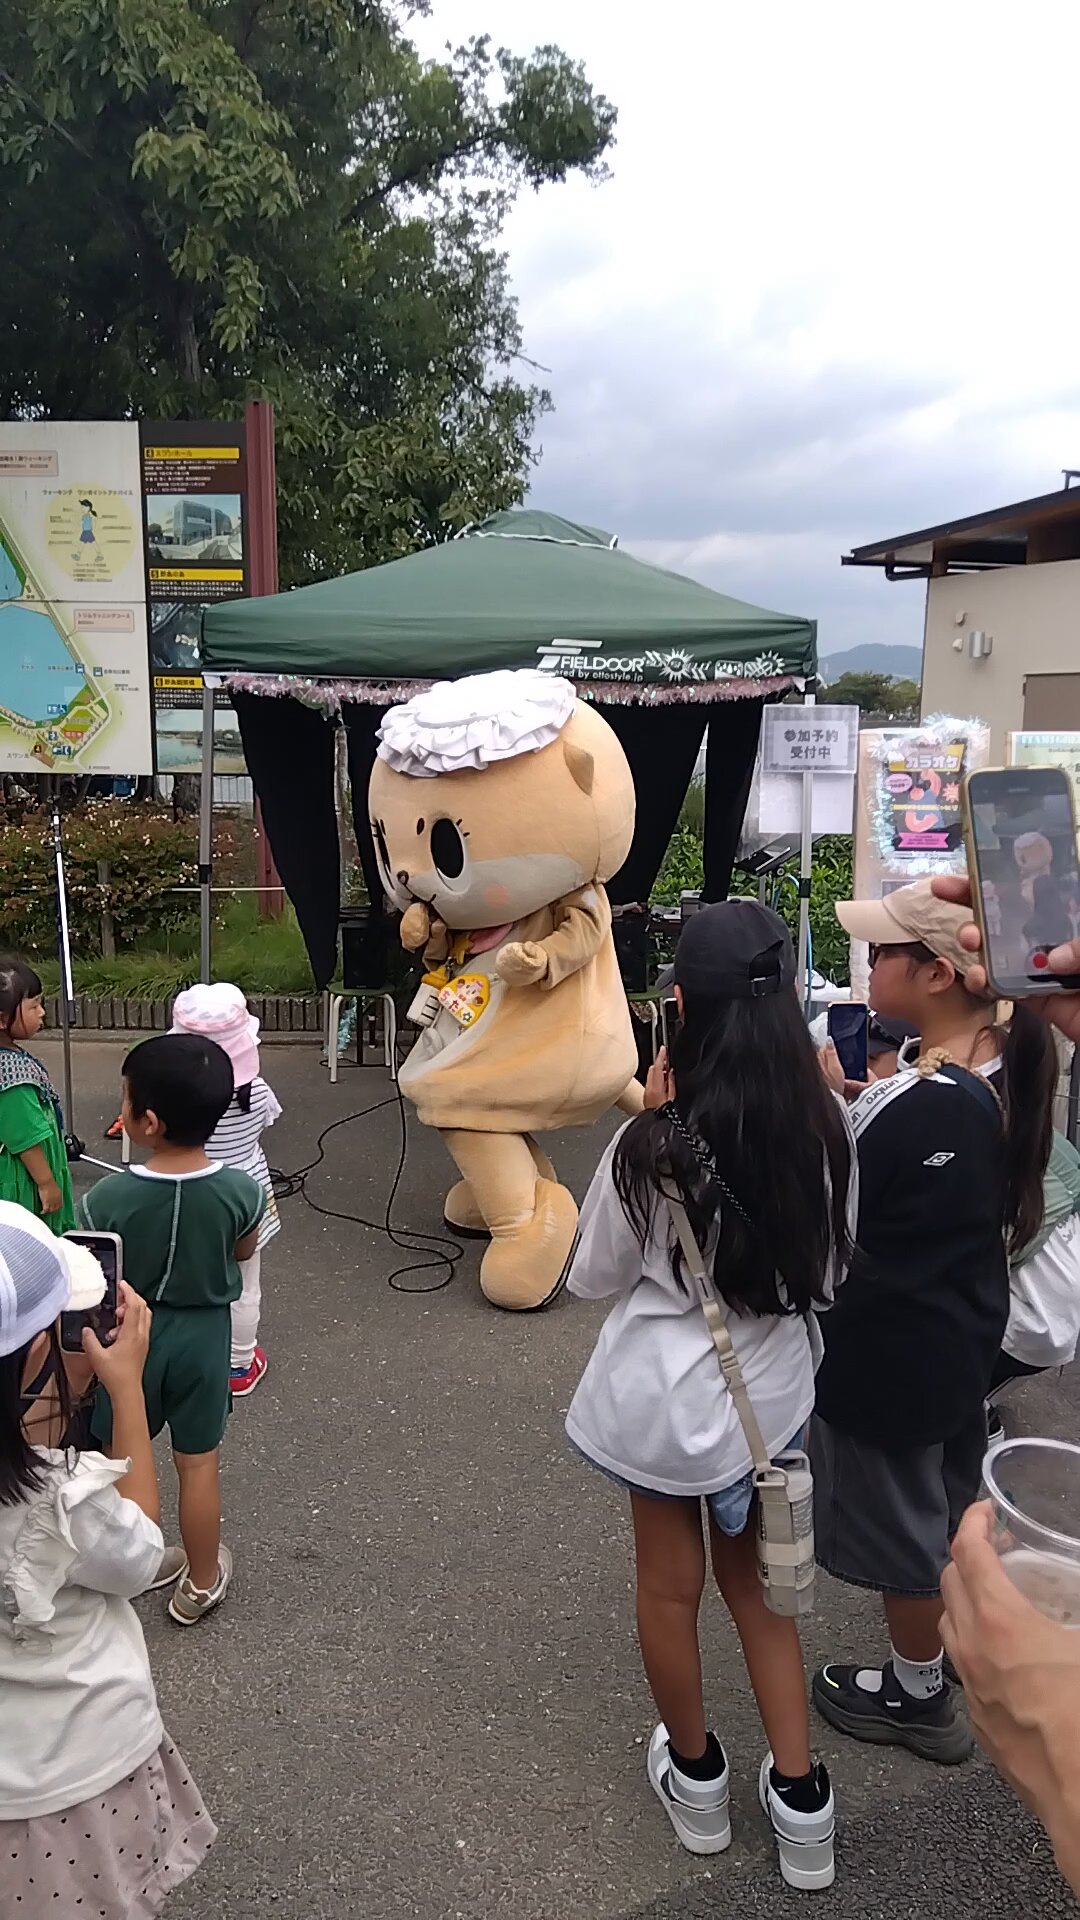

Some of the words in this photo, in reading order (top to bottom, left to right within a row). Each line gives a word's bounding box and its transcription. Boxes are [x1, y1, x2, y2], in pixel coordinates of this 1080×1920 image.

[560, 656, 645, 672] FIELDOOR
[578, 671, 589, 680] by
[592, 673, 643, 682] ottostyle.jp
[784, 729, 839, 743] 参加予約
[790, 746, 831, 759] 受付中
[905, 754, 959, 769] カラオケ
[866, 1080, 899, 1105] umbro
